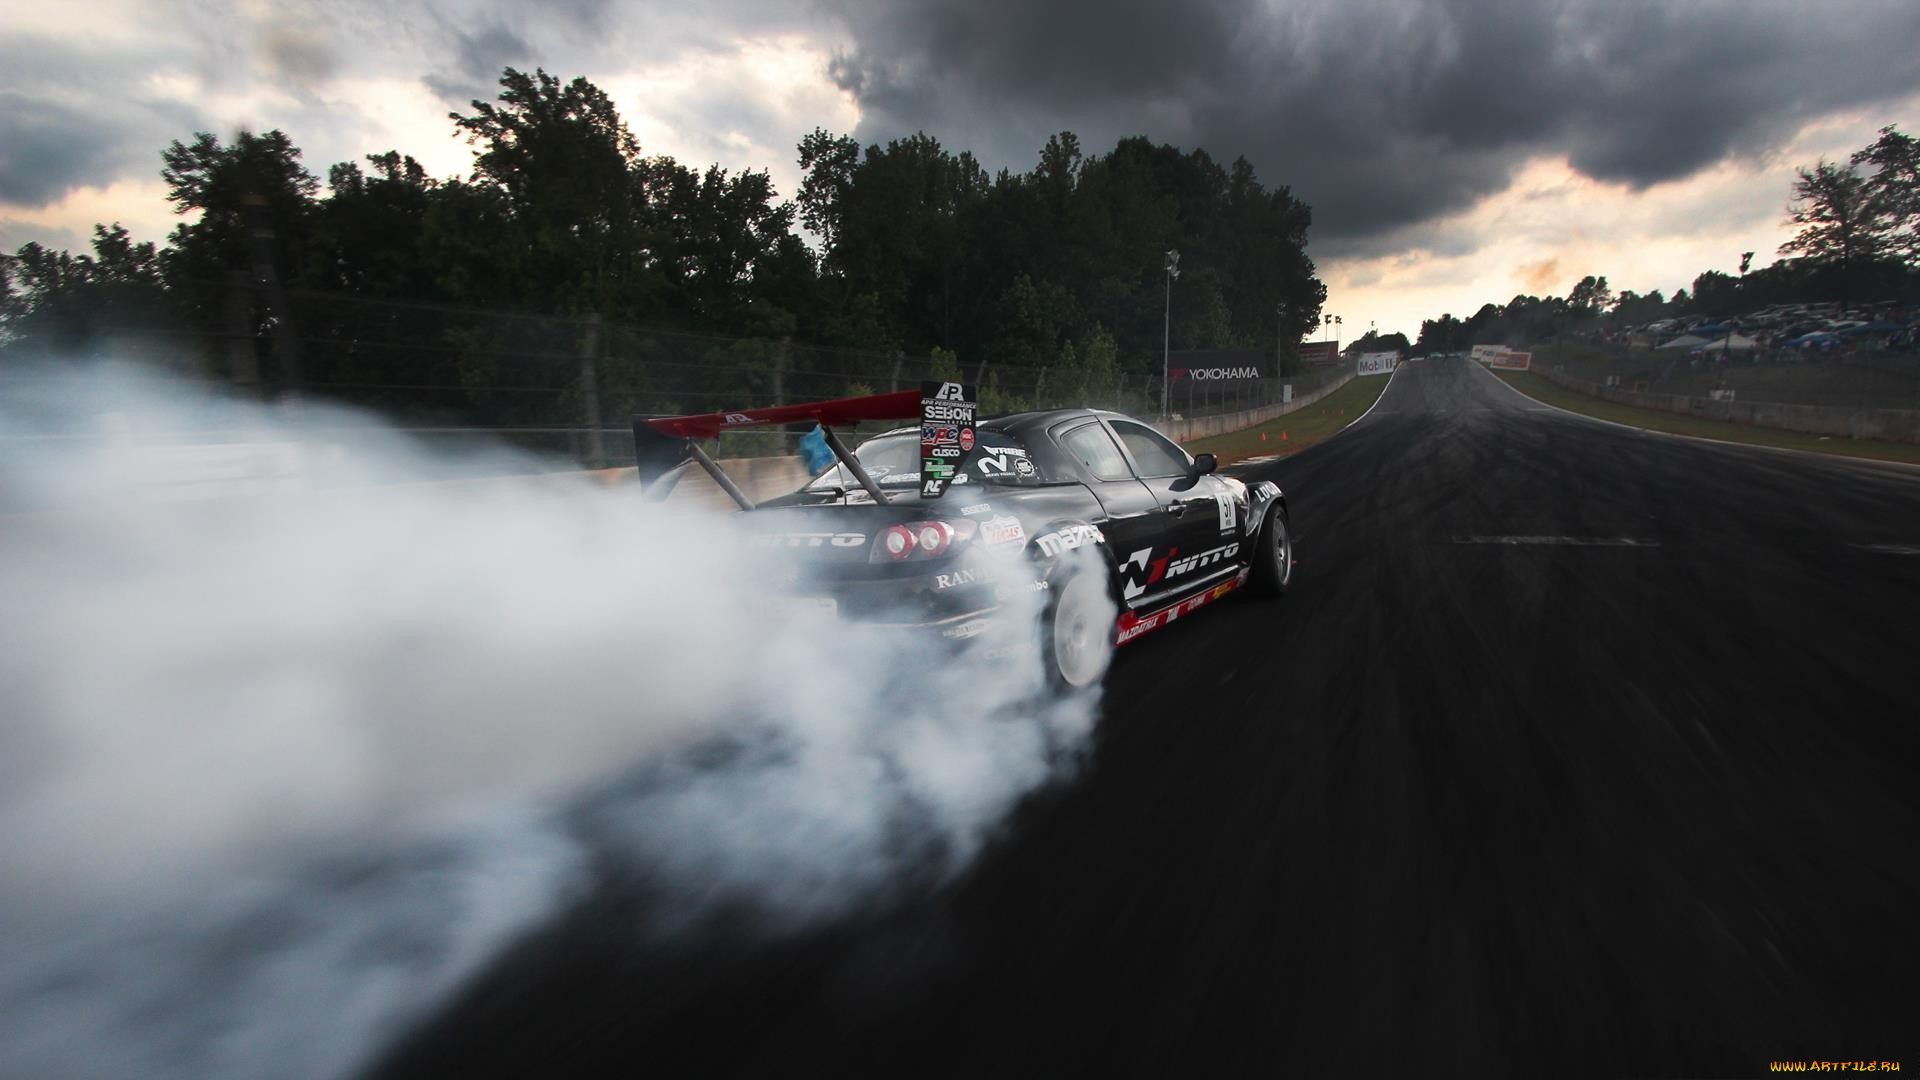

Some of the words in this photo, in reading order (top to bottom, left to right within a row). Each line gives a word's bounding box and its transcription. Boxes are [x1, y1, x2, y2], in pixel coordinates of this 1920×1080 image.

[1189, 366, 1259, 381] YOKOHAMA
[1359, 360, 1384, 378] Mobil
[932, 449, 961, 457] CUSCO
[1165, 542, 1240, 579] NITTO
